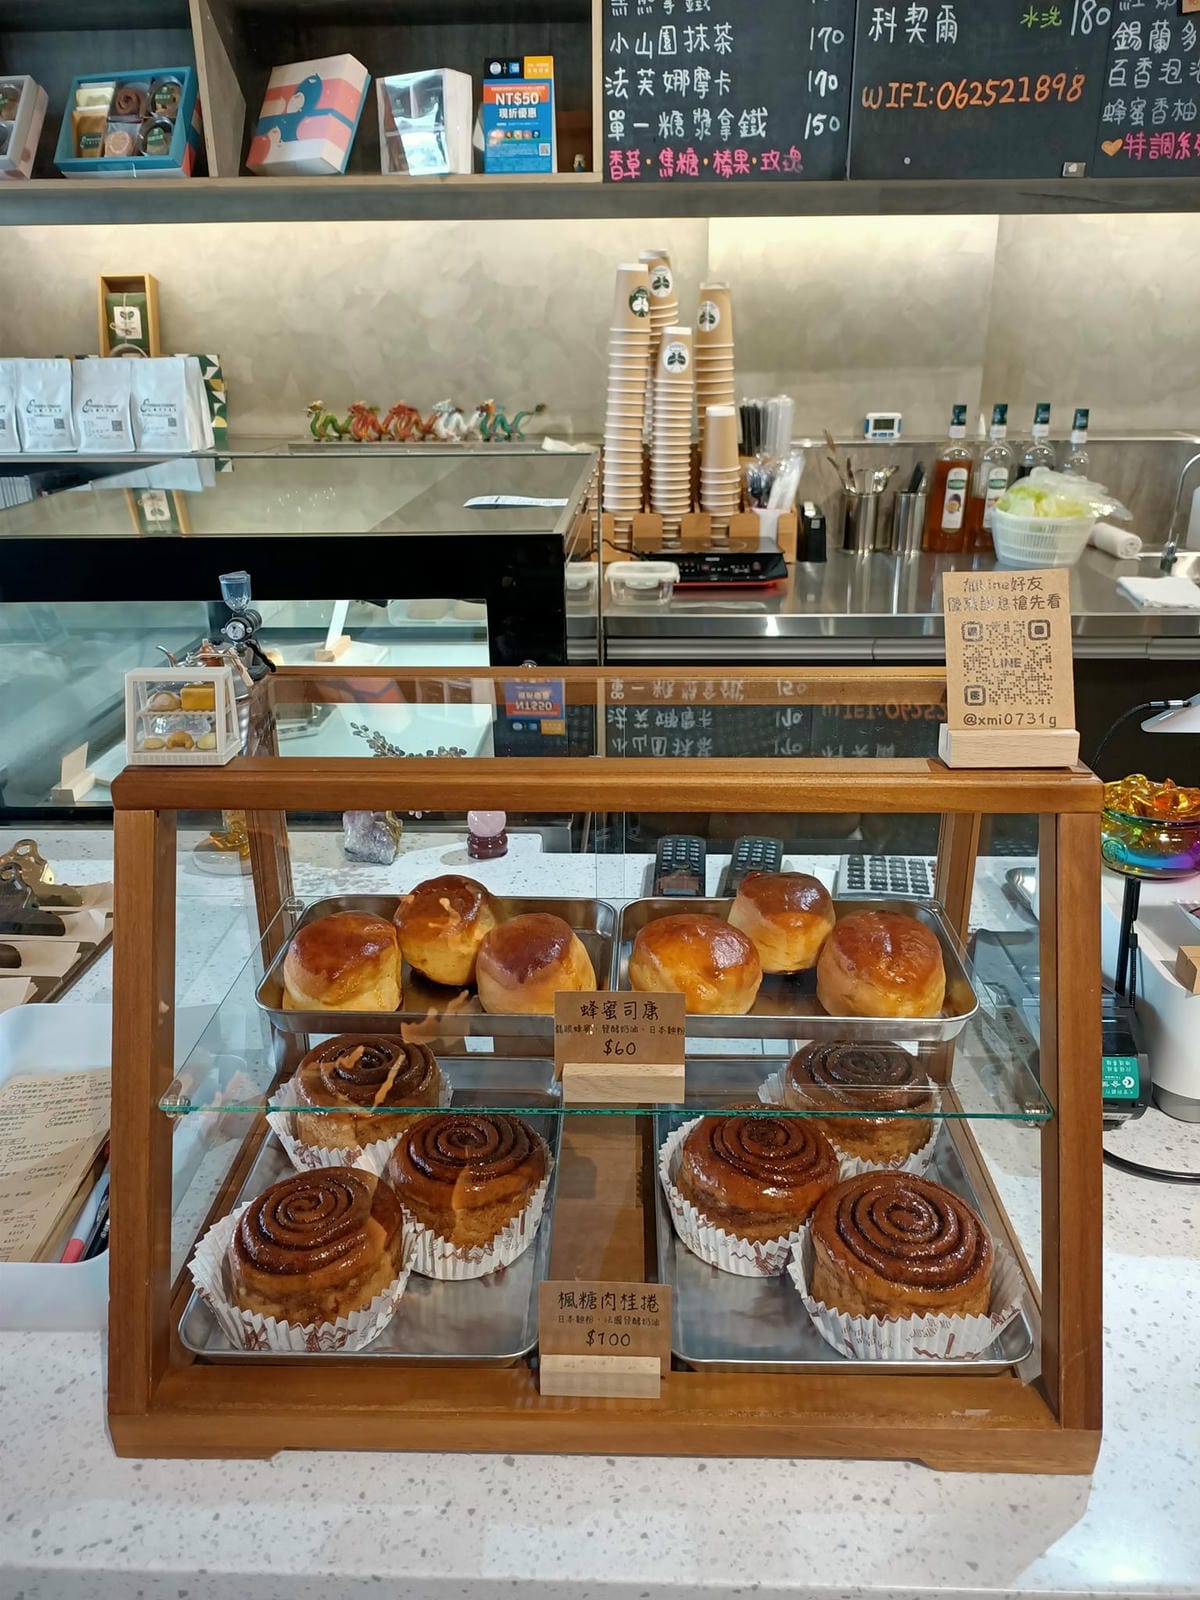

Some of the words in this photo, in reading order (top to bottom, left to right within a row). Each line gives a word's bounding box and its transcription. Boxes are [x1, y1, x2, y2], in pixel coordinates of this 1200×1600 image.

[1070, 0, 1111, 36] 180
[809, 27, 845, 52] 170
[605, 66, 732, 99] 法芙娜摩卡
[808, 70, 838, 97] 170
[495, 91, 540, 106] NT$50
[804, 113, 840, 140] 150
[992, 657, 1021, 669] LINE
[963, 712, 1057, 728] @xmi0731g
[580, 1000, 659, 1021] 蜂蜜司康
[603, 1038, 637, 1056] $60
[558, 1290, 660, 1313] 楓糖肉桂捲
[586, 1329, 631, 1347] $100
